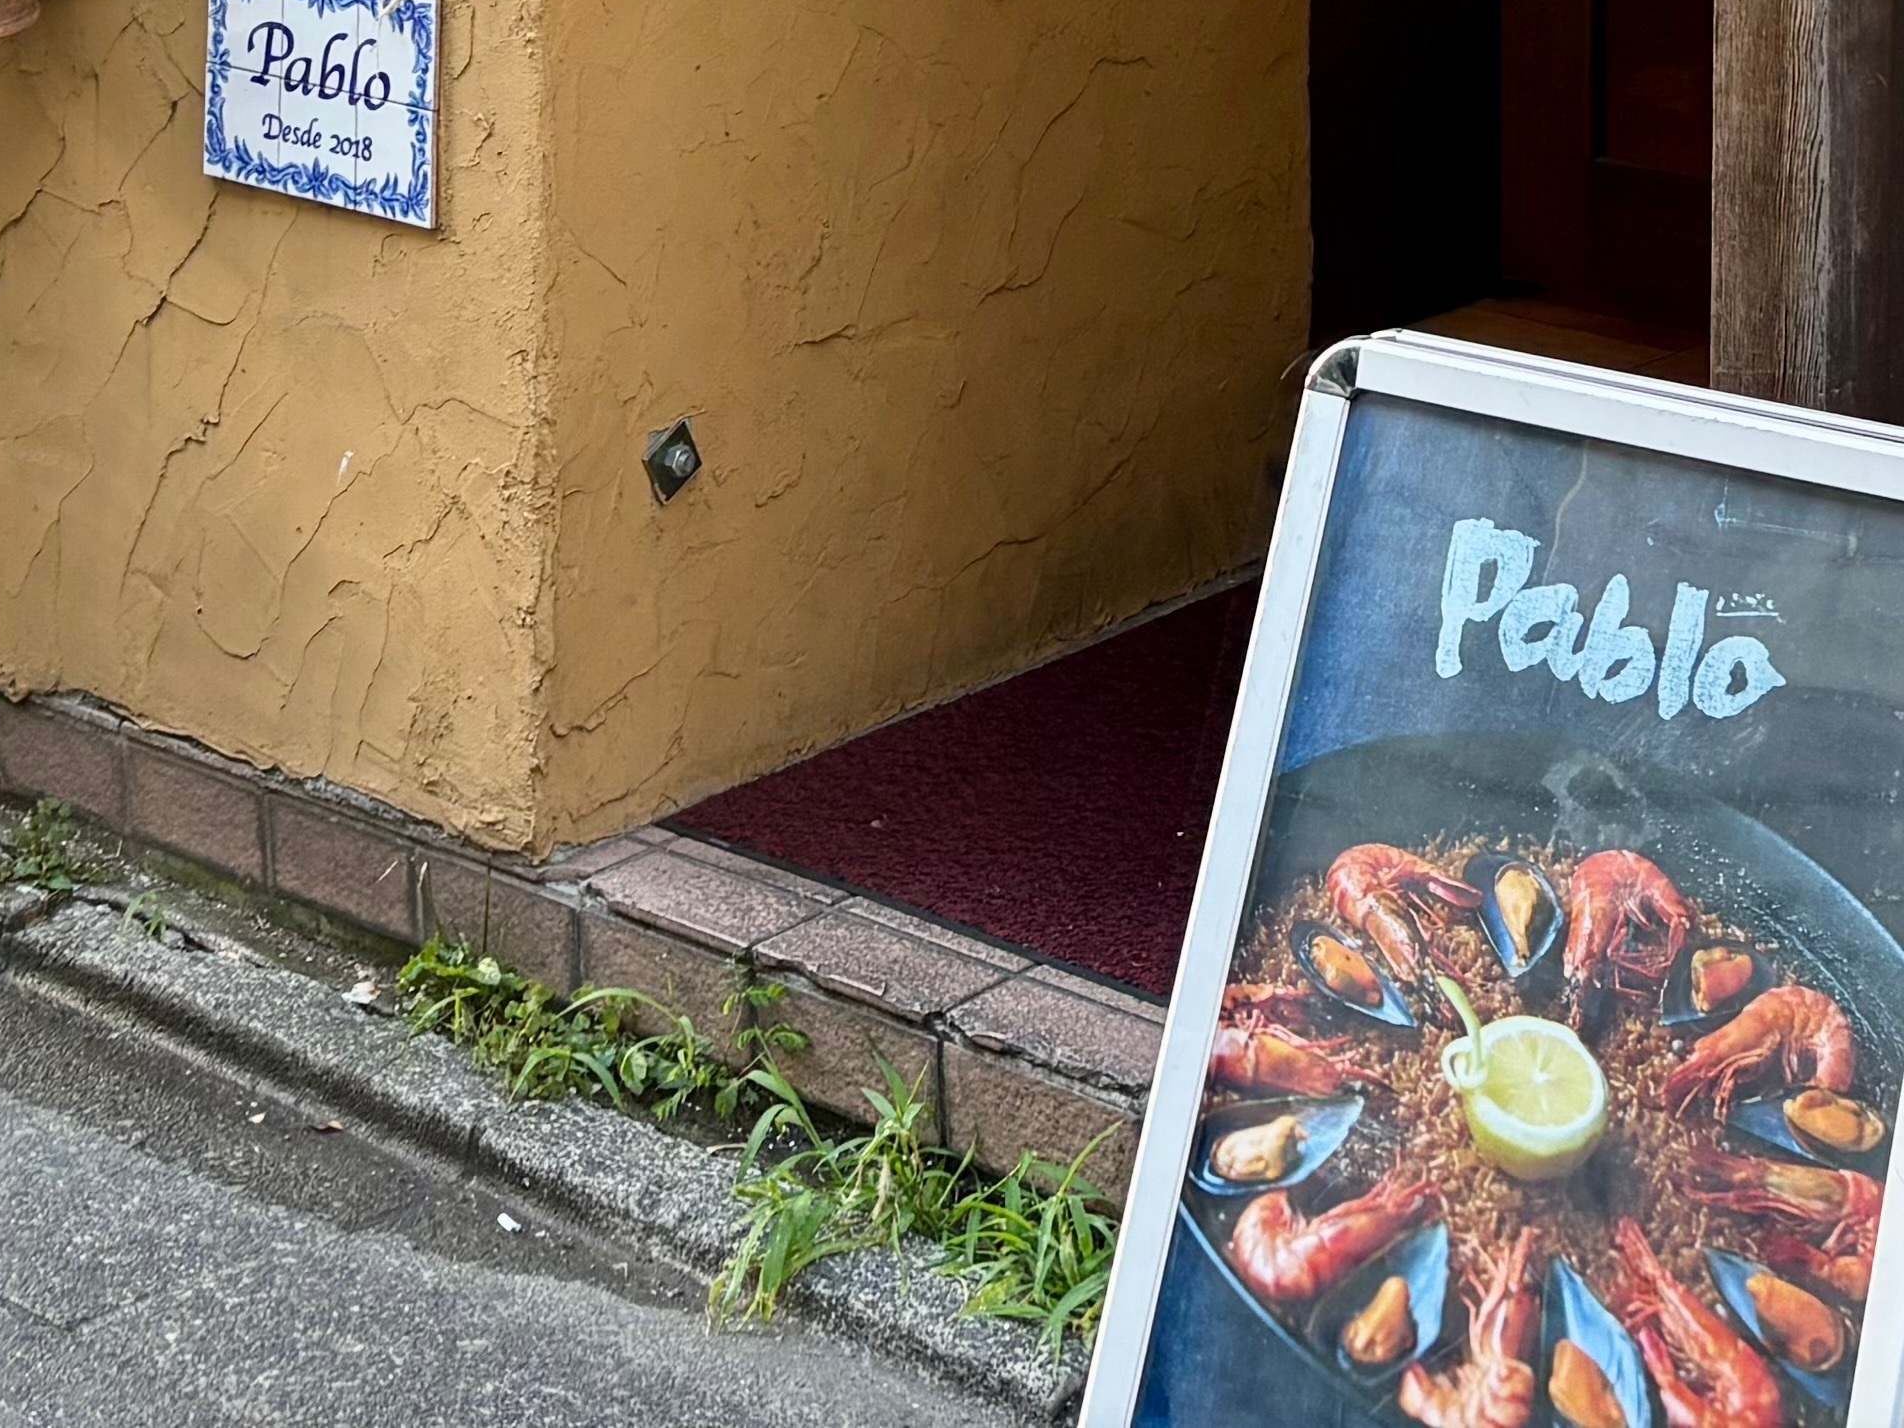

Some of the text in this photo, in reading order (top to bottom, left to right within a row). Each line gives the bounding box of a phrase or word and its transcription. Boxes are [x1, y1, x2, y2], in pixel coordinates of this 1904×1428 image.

[246, 20, 391, 112] Pablo
[261, 113, 374, 163] Desde 2018
[1435, 516, 1786, 722] Pablo
